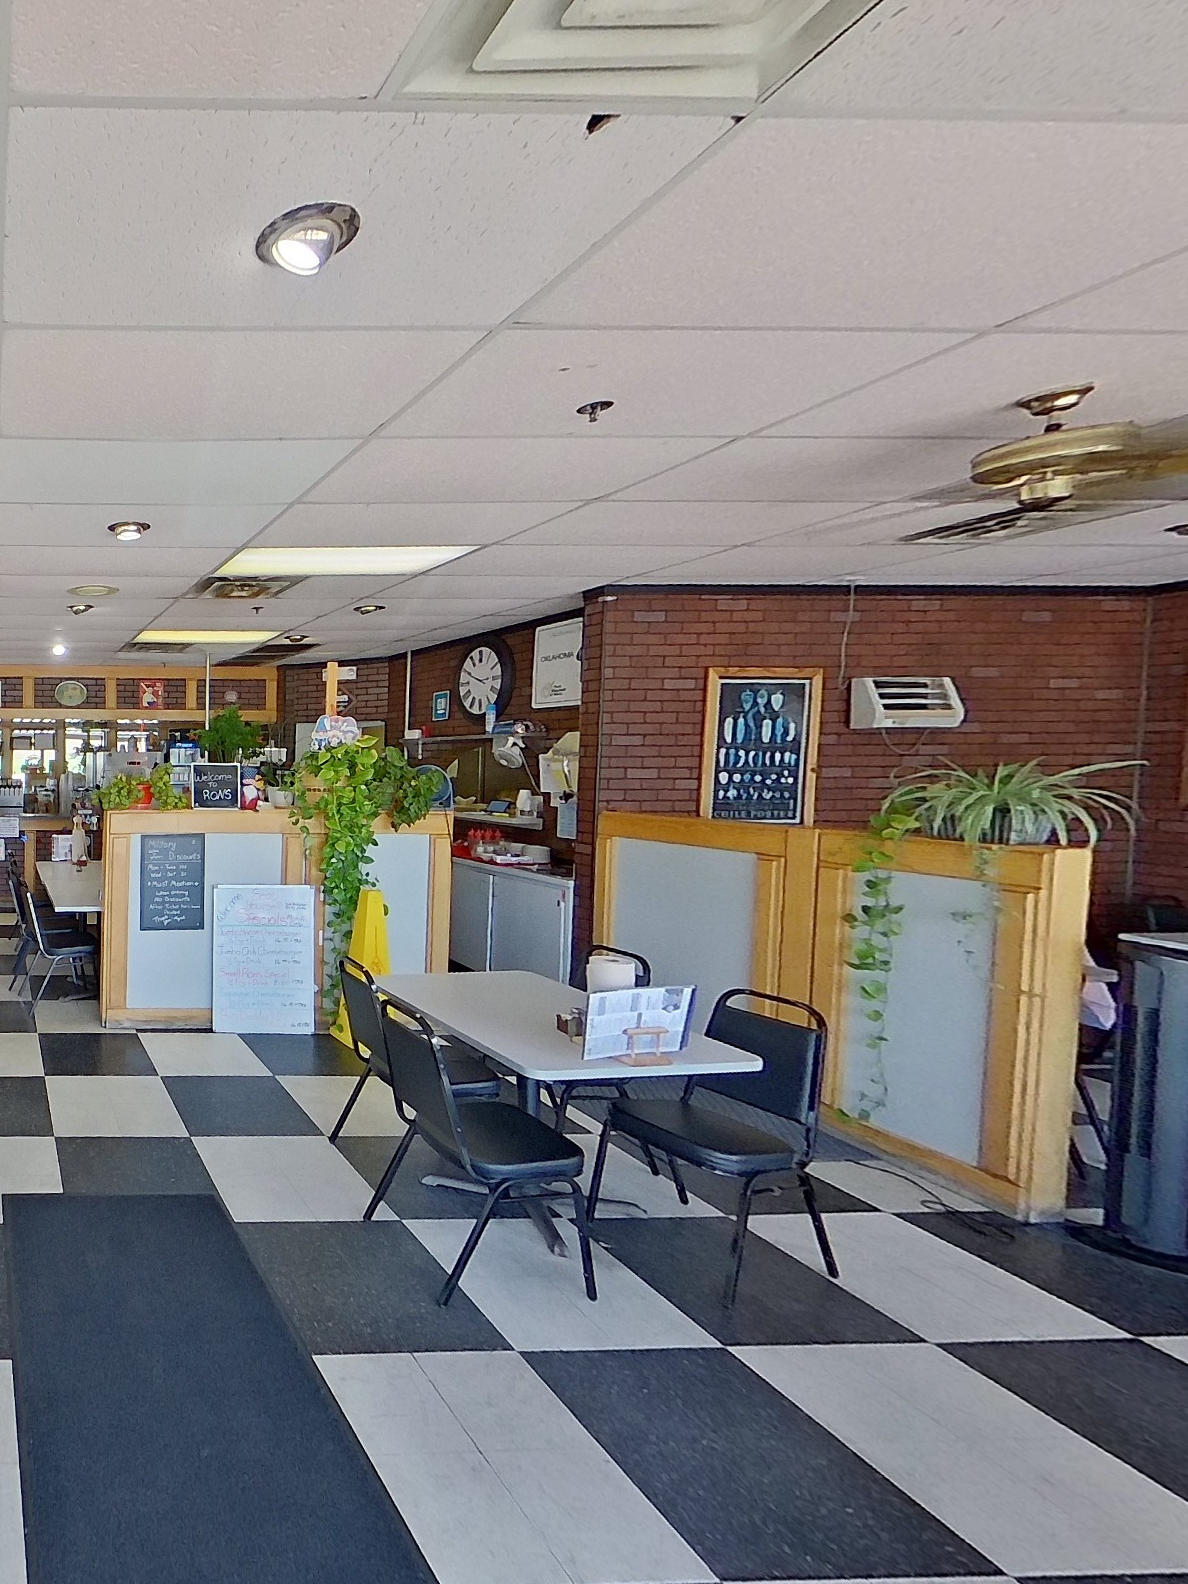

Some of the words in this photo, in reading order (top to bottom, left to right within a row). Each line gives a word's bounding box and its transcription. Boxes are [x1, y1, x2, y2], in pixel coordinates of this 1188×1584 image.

[540, 651, 574, 663] OKLAHOMA
[194, 771, 232, 782] Welcome
[750, 810, 794, 818] POSTER
[148, 840, 176, 851] Military
